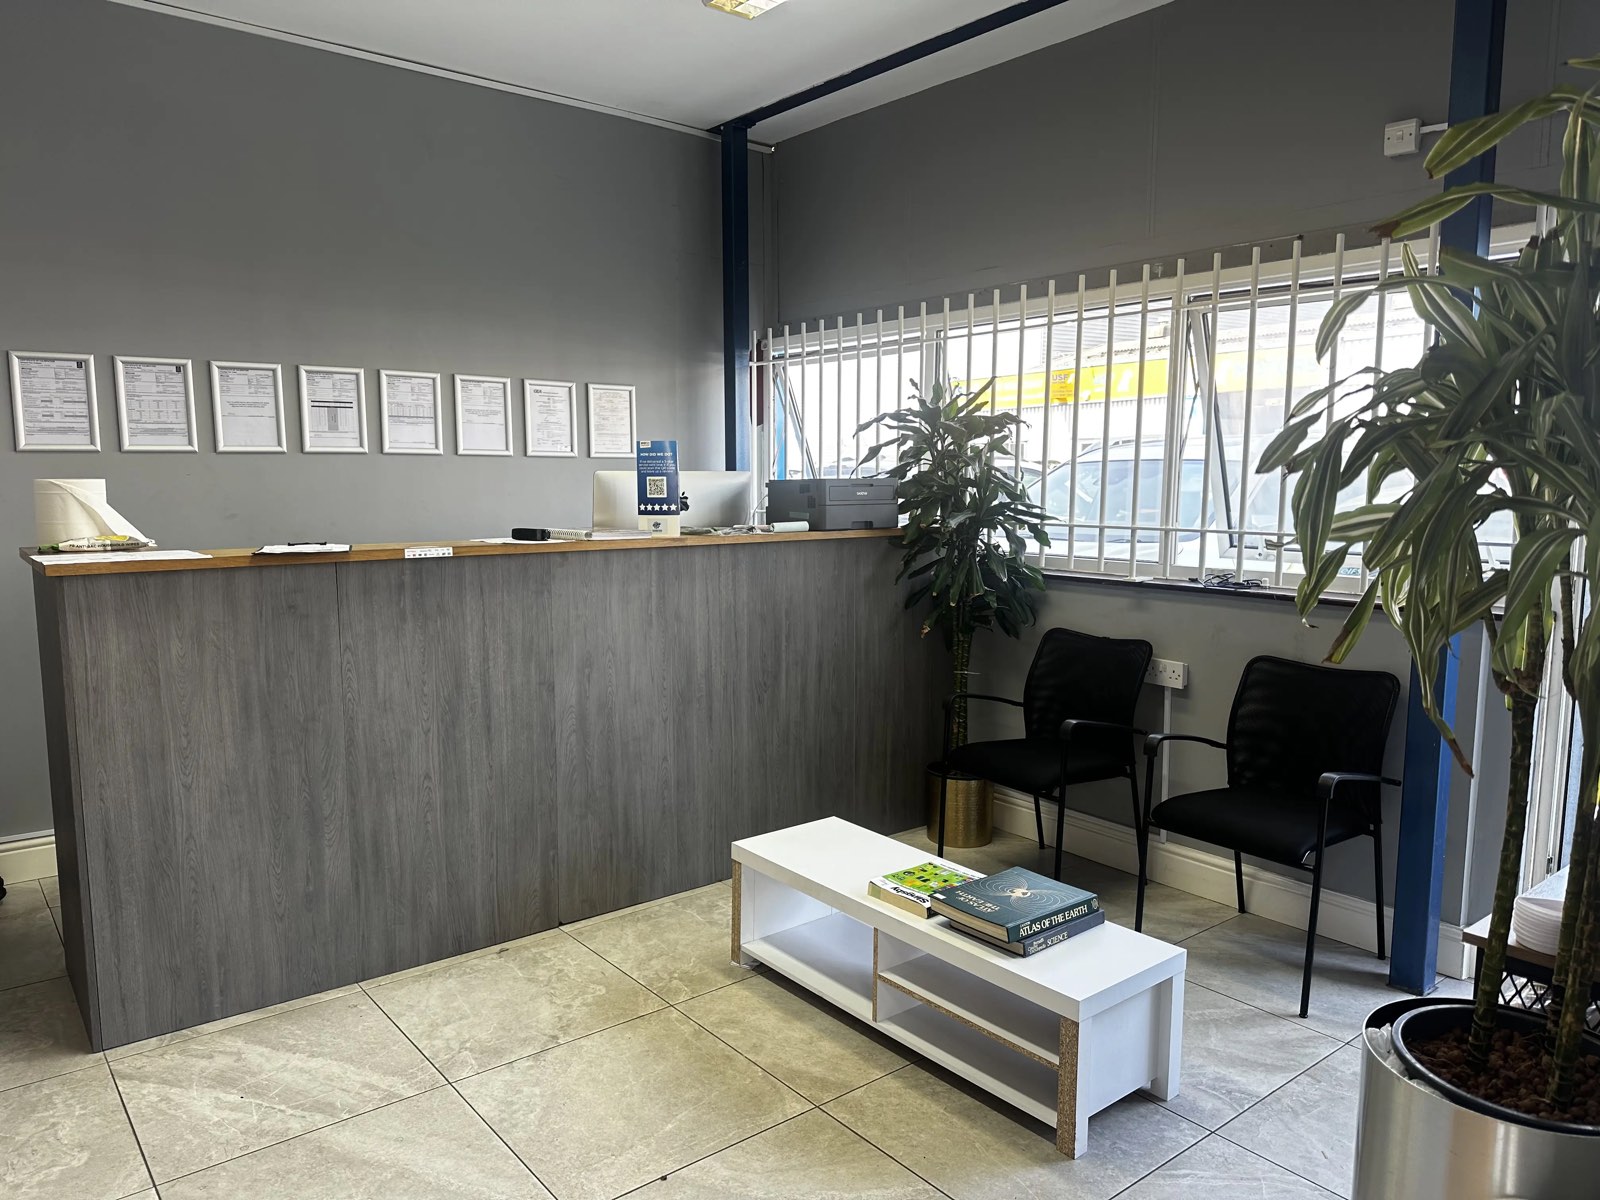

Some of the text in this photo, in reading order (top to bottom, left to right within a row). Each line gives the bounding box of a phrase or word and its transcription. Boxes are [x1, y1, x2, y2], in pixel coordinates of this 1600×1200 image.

[1019, 905, 1088, 937] ATLAS OF THE EARTH
[1047, 932, 1068, 947] SCIENCE
